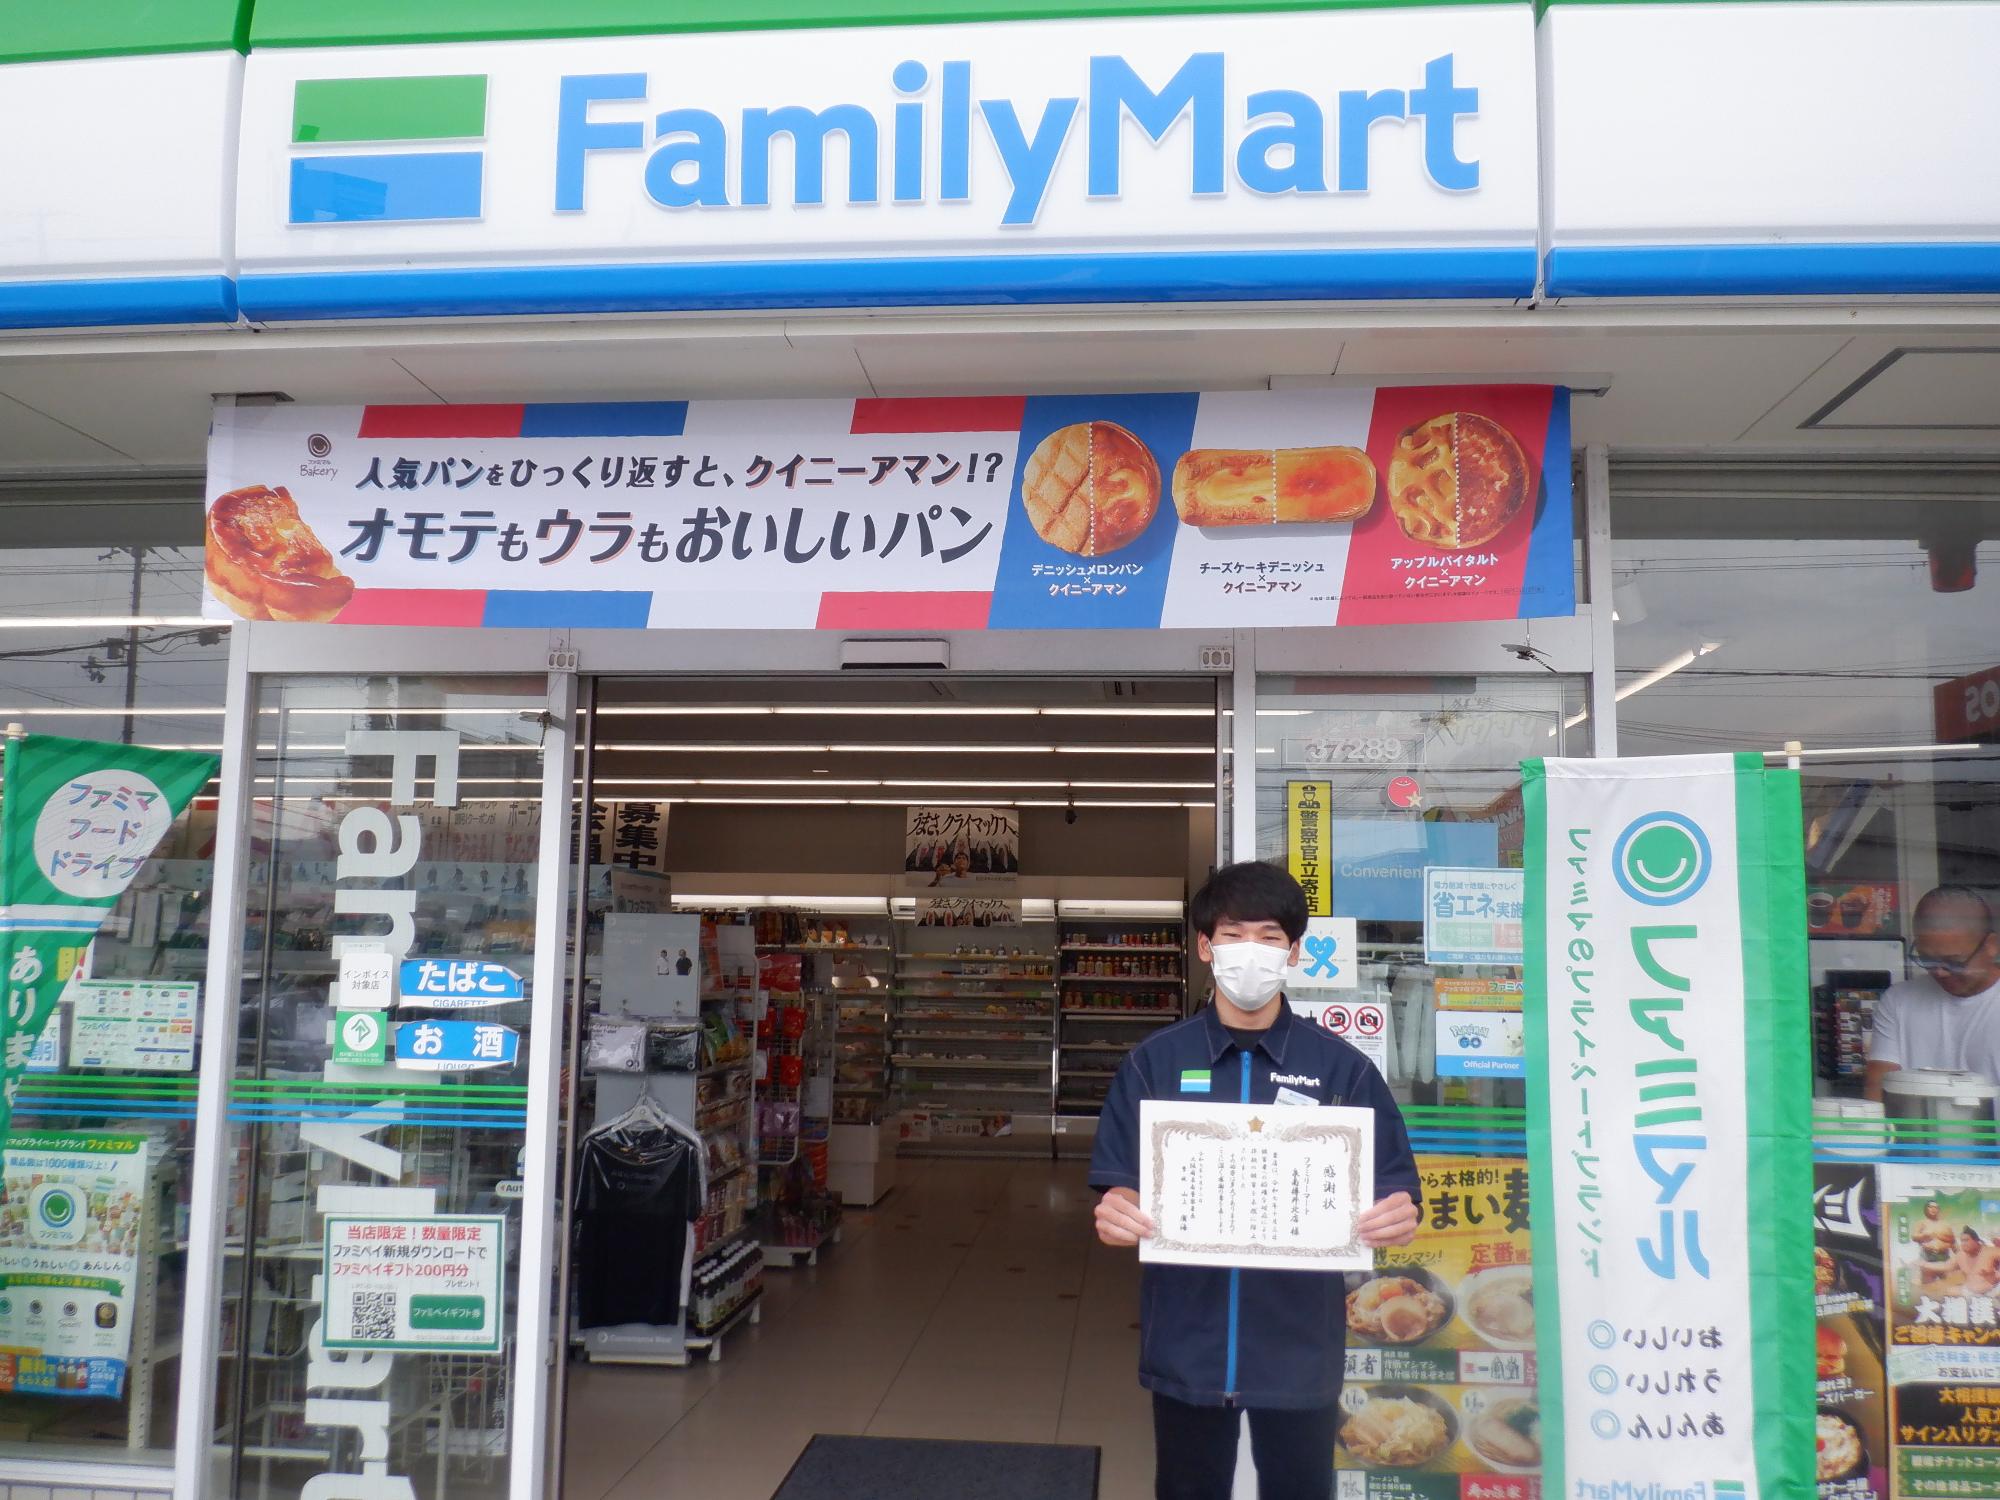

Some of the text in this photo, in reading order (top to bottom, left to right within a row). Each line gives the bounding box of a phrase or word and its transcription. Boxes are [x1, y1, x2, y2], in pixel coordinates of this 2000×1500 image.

[554, 49, 1483, 228] FamilyMart
[300, 464, 339, 481] Bakery
[340, 504, 994, 567] オモテもウラもおいしいパン
[1031, 561, 1144, 577] デニッシュメロンパン
[1199, 558, 1326, 576] チーズケーキデニッシュ
[1047, 582, 1129, 597] クイニーアマン
[1222, 580, 1303, 595] クイニーアマン
[1403, 573, 1488, 591] クイニーアマン
[69, 782, 160, 812] ファミマ
[68, 819, 143, 845] フード
[1340, 863, 1425, 879] Convenien
[343, 969, 390, 979] インボイス
[418, 961, 505, 992] たばこ
[351, 979, 381, 990] 対象店
[1458, 1036, 1482, 1049] GO
[1463, 1060, 1520, 1070] Official Partner
[1270, 1072, 1320, 1087] FamilyMart
[1303, 1156, 1312, 1216] ファミリーマート
[1420, 1168, 1500, 1189] ら本格的!
[1321, 1163, 1337, 1211] 感謝状
[348, 1225, 482, 1241] 当店限定!数量限定
[333, 1244, 488, 1260] ファミペイ新規ダウンロードで
[333, 1263, 469, 1278] ファミペイギフト200円分
